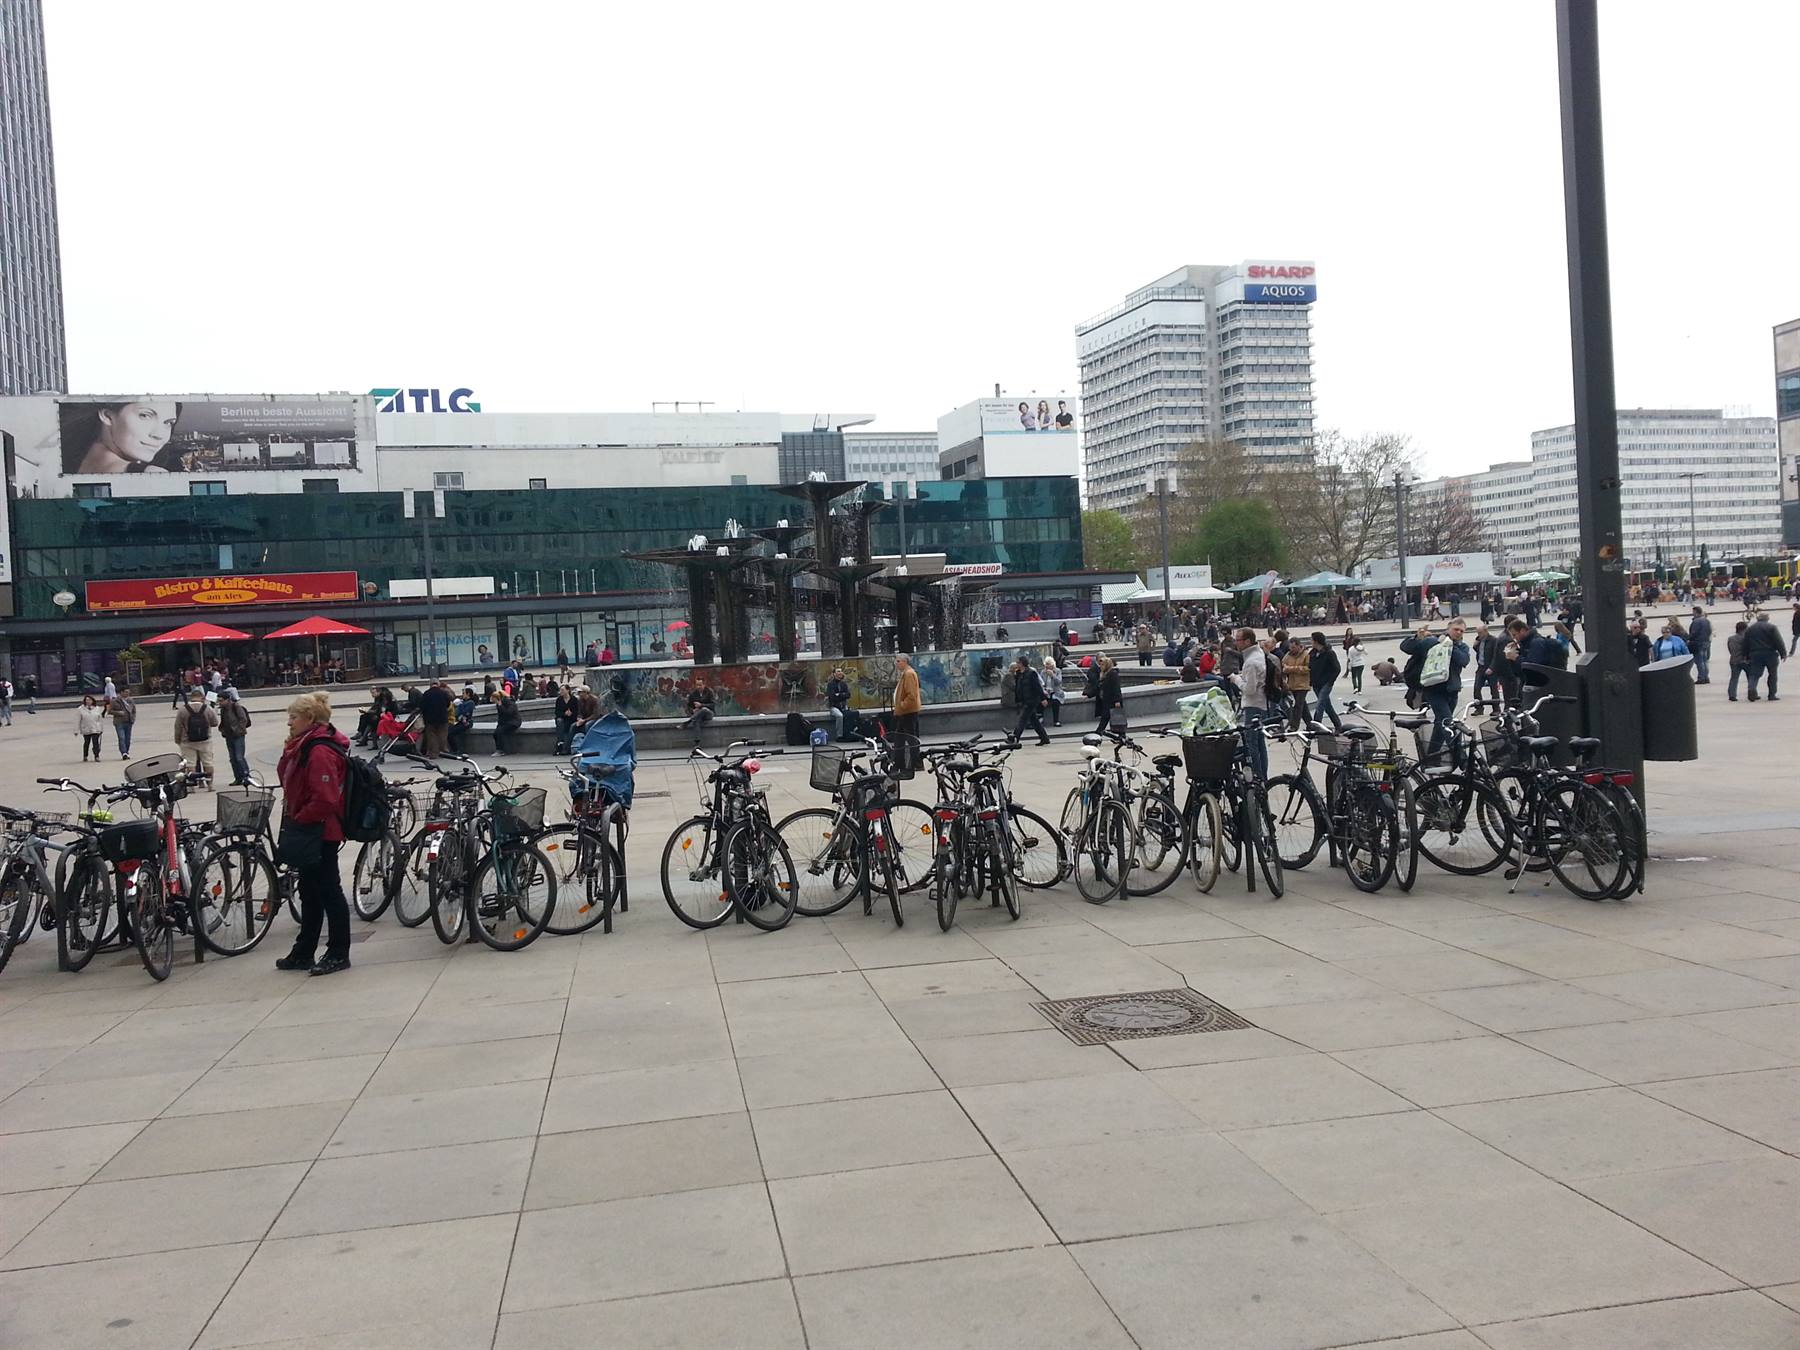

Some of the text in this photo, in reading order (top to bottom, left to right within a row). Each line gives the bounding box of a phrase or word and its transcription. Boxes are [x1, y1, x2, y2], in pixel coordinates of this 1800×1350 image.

[1247, 265, 1315, 279] SHARP
[1261, 285, 1305, 298] AQUOS
[220, 406, 260, 417] Berlins
[262, 406, 293, 417] beste
[154, 577, 294, 599] Bistro & Kaffeehaus
[423, 634, 492, 646] DMNÄCHST
